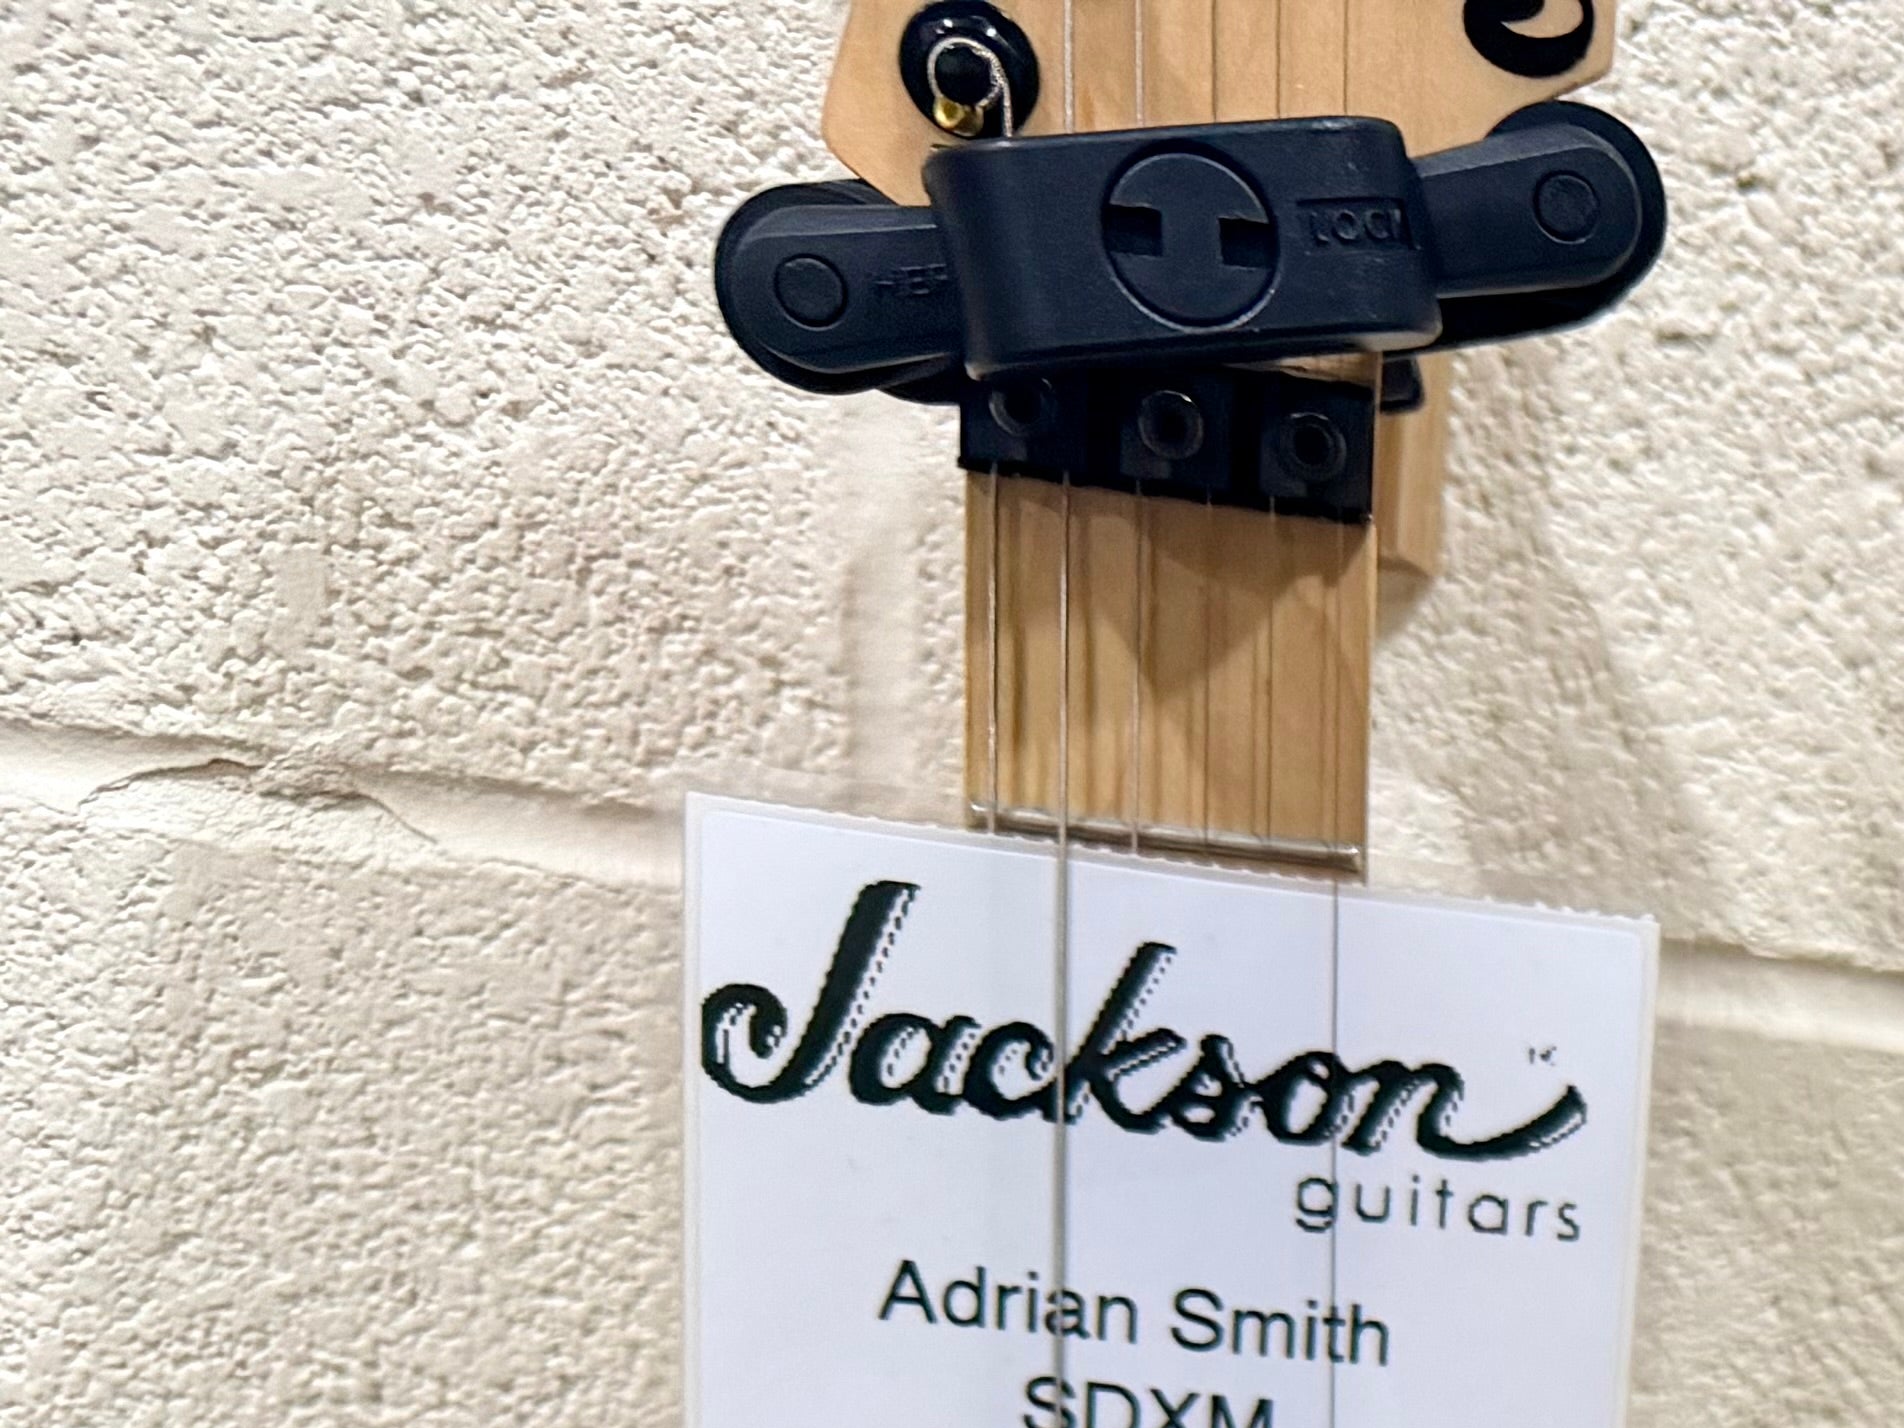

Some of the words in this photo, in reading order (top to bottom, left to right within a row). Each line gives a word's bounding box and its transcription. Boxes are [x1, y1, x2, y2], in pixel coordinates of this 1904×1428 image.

[701, 878, 1587, 1162] Jackson
[1295, 1176, 1583, 1243] guitars
[878, 1259, 1138, 1343] Adrian
[1169, 1287, 1390, 1367] Smith
